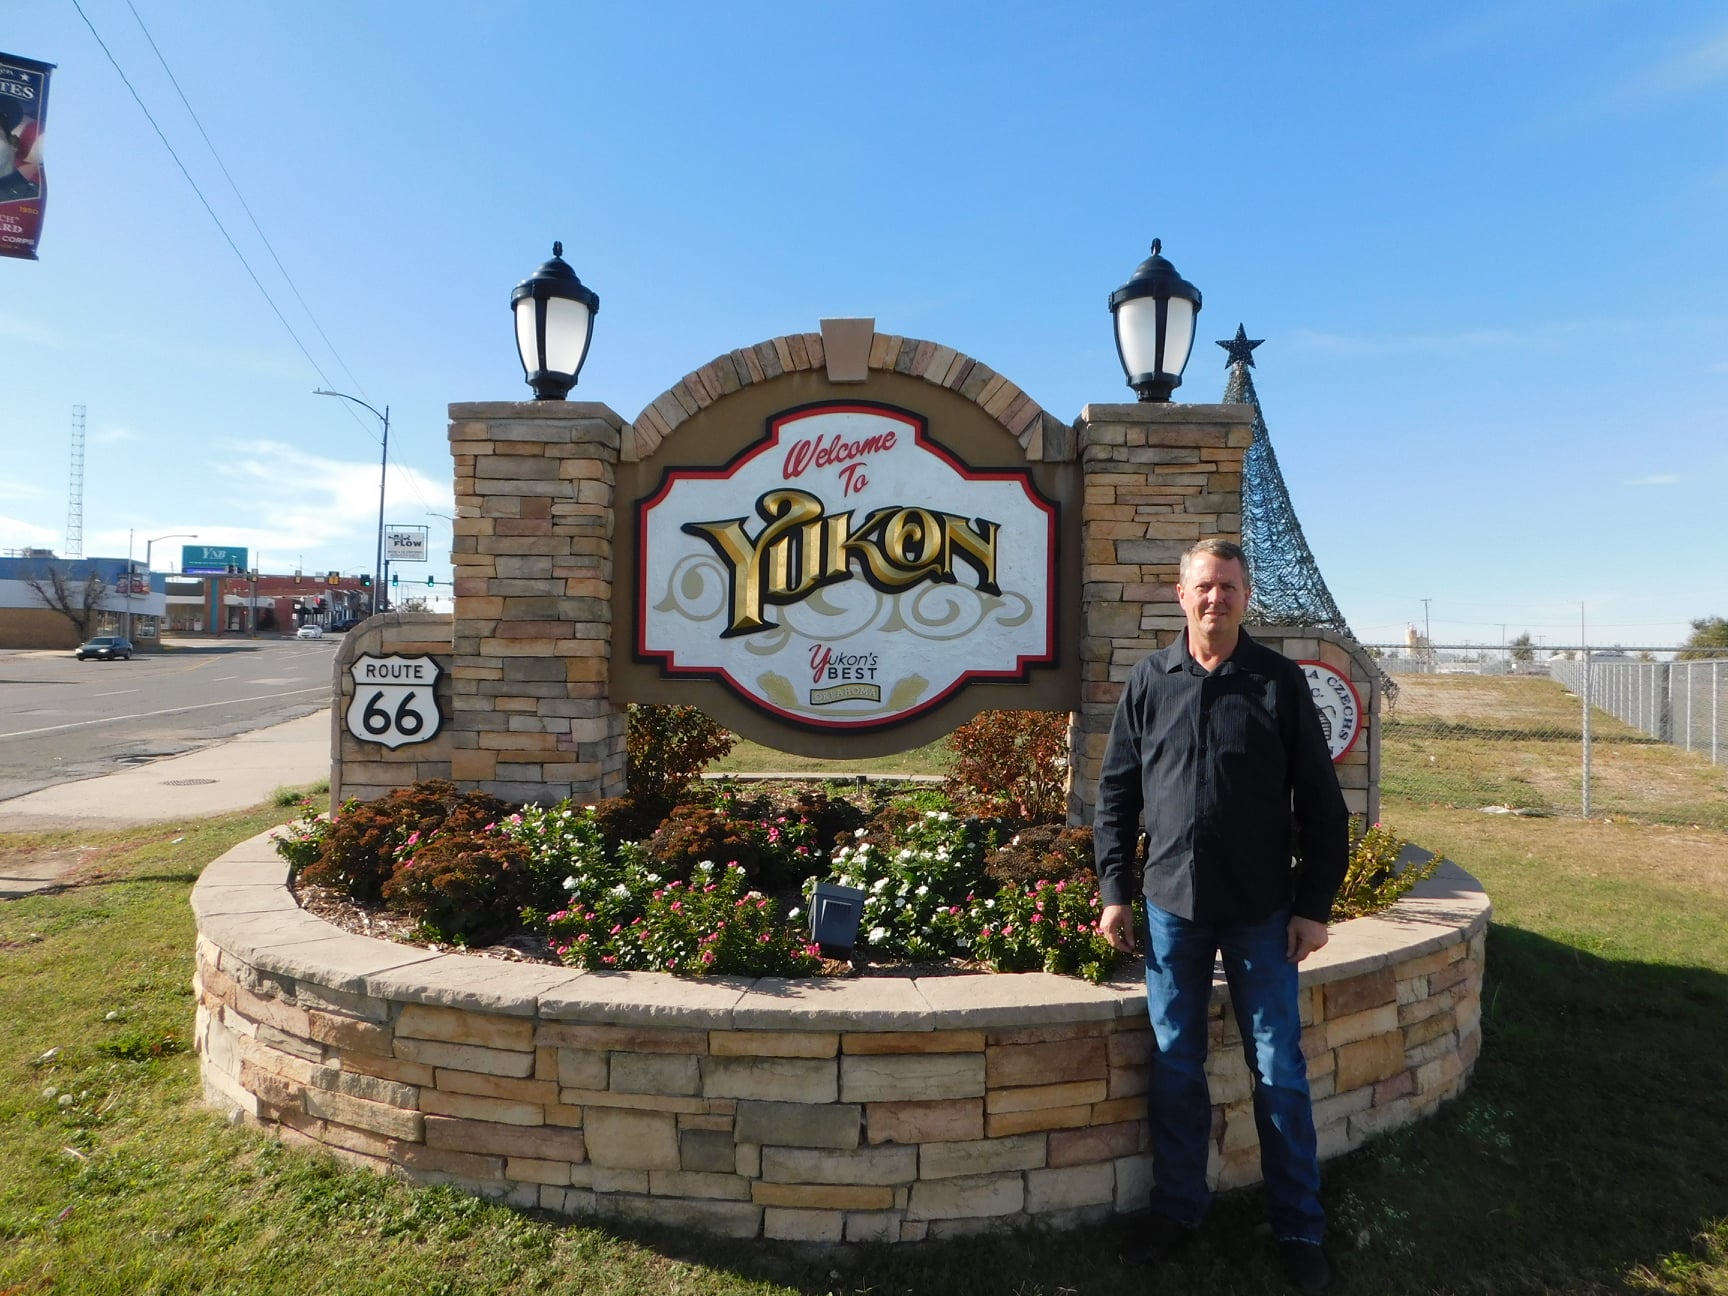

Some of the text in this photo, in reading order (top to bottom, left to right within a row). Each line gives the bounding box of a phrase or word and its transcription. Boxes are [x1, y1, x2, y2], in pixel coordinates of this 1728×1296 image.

[783, 431, 898, 480] Welcome
[838, 462, 869, 498] To
[680, 487, 1003, 639] YUKON
[366, 664, 424, 679] ROUTE
[828, 667, 878, 680] BEST
[362, 690, 424, 736] 66
[815, 687, 877, 701] OKLAHOMA
[1326, 676, 1354, 741] CZECHS
